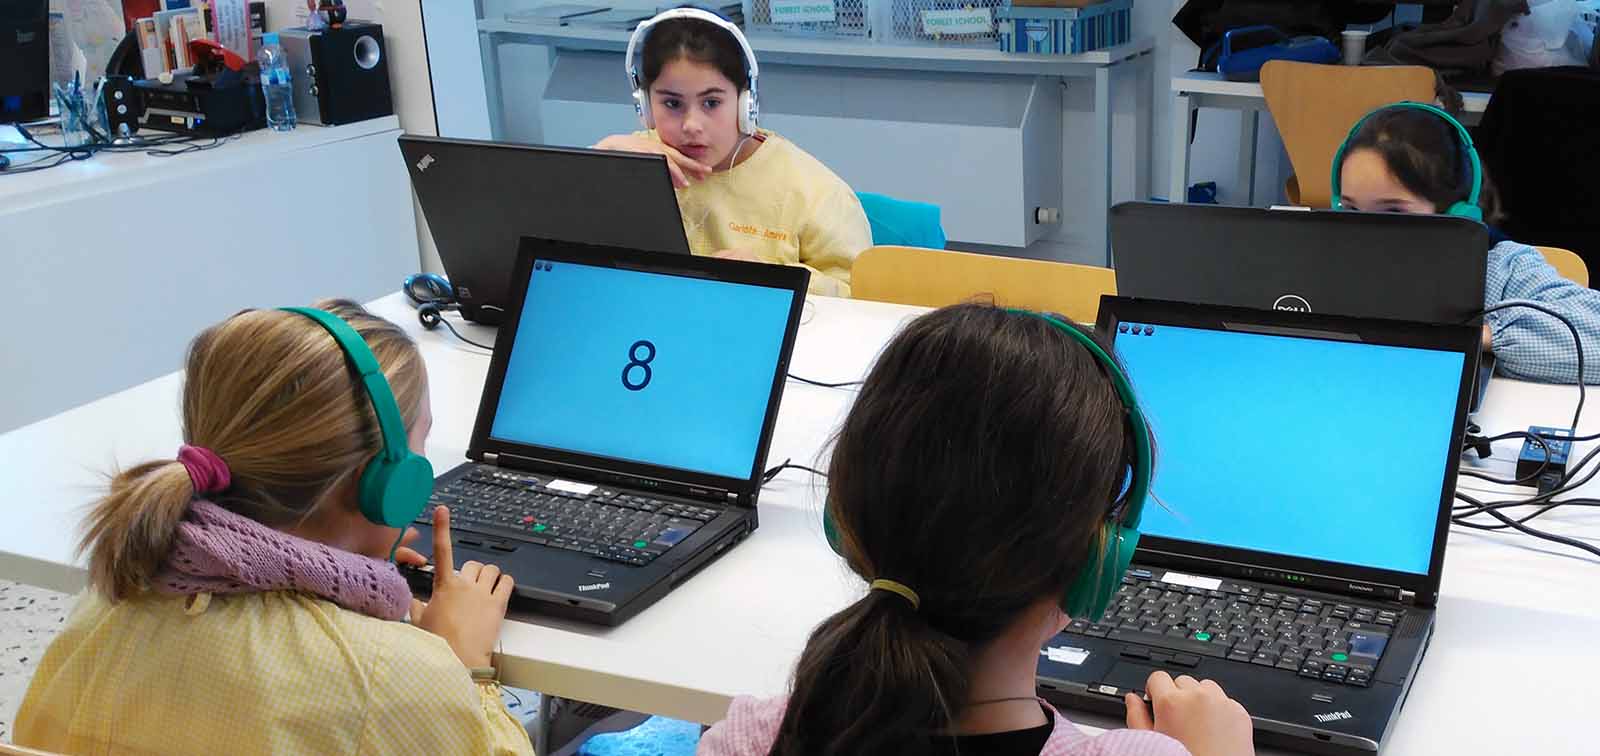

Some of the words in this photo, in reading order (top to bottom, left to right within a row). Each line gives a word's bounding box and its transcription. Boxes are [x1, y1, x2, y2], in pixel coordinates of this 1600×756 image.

[621, 340, 656, 391] 8
[578, 582, 610, 591] ThinkPad
[1313, 710, 1352, 722] ThinkPad
